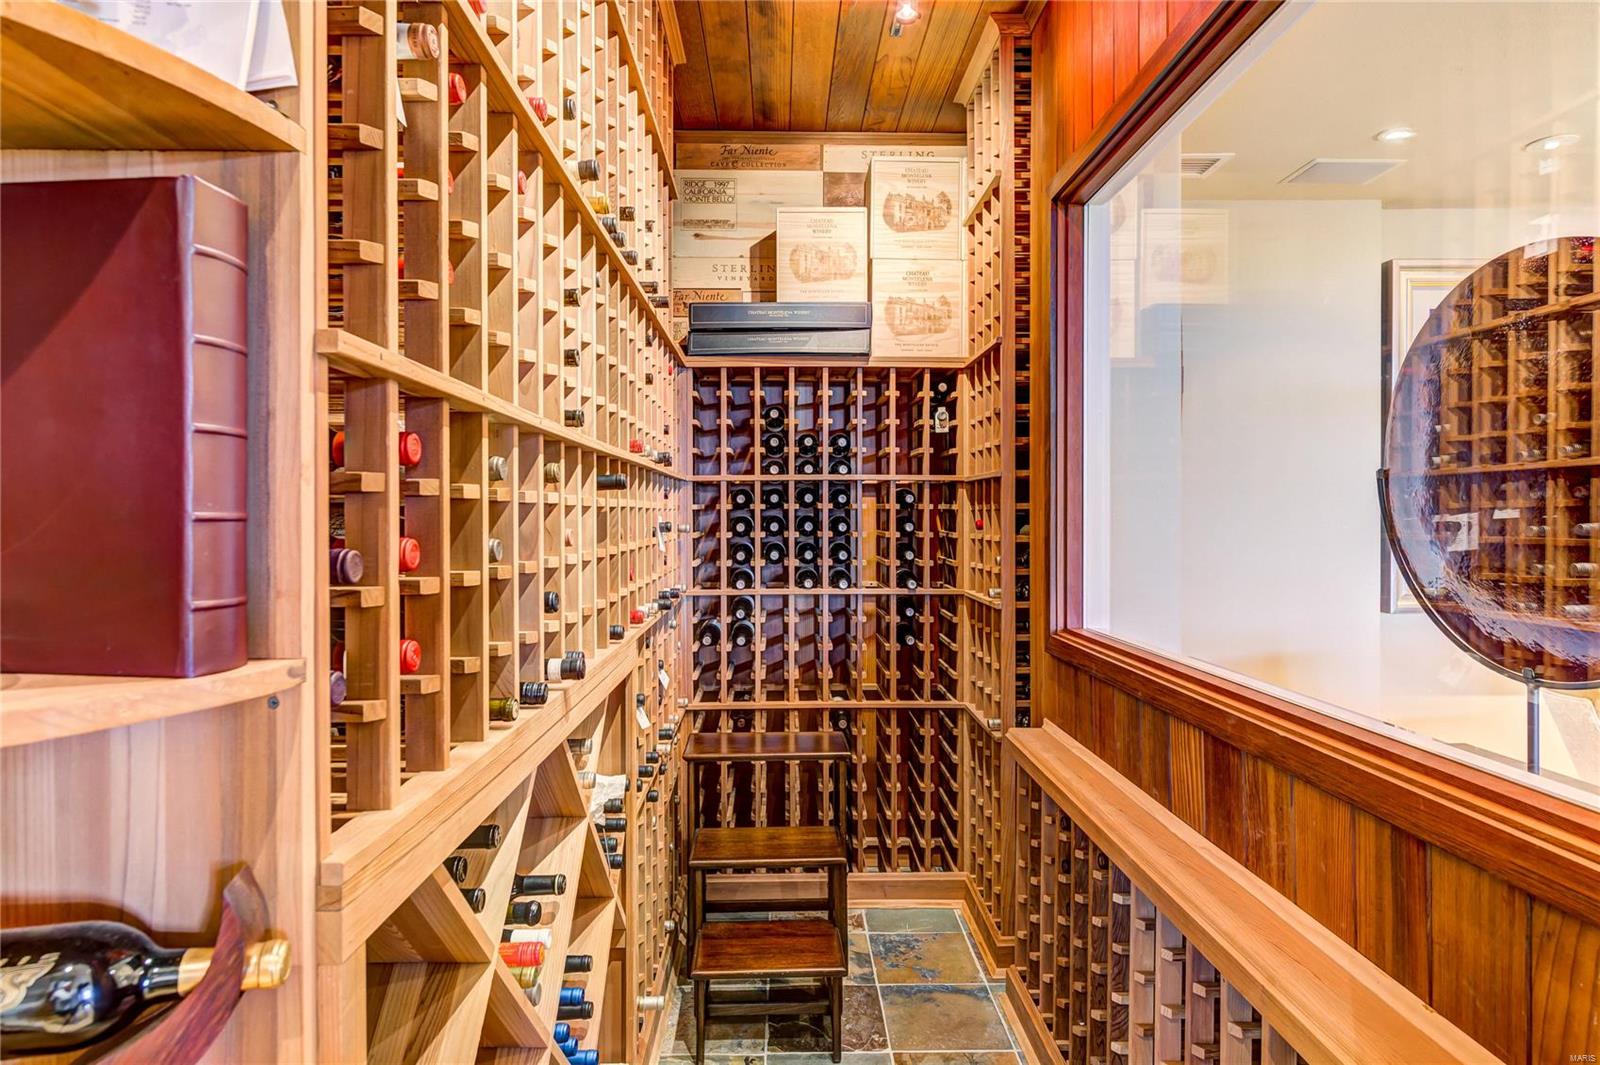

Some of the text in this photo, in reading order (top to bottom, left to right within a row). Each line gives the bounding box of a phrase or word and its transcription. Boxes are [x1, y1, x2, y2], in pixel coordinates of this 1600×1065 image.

[720, 145, 778, 156] Far Niente
[684, 195, 735, 203] MONTE BELLO
[712, 264, 776, 273] STERLIN
[691, 290, 729, 301] Niente
